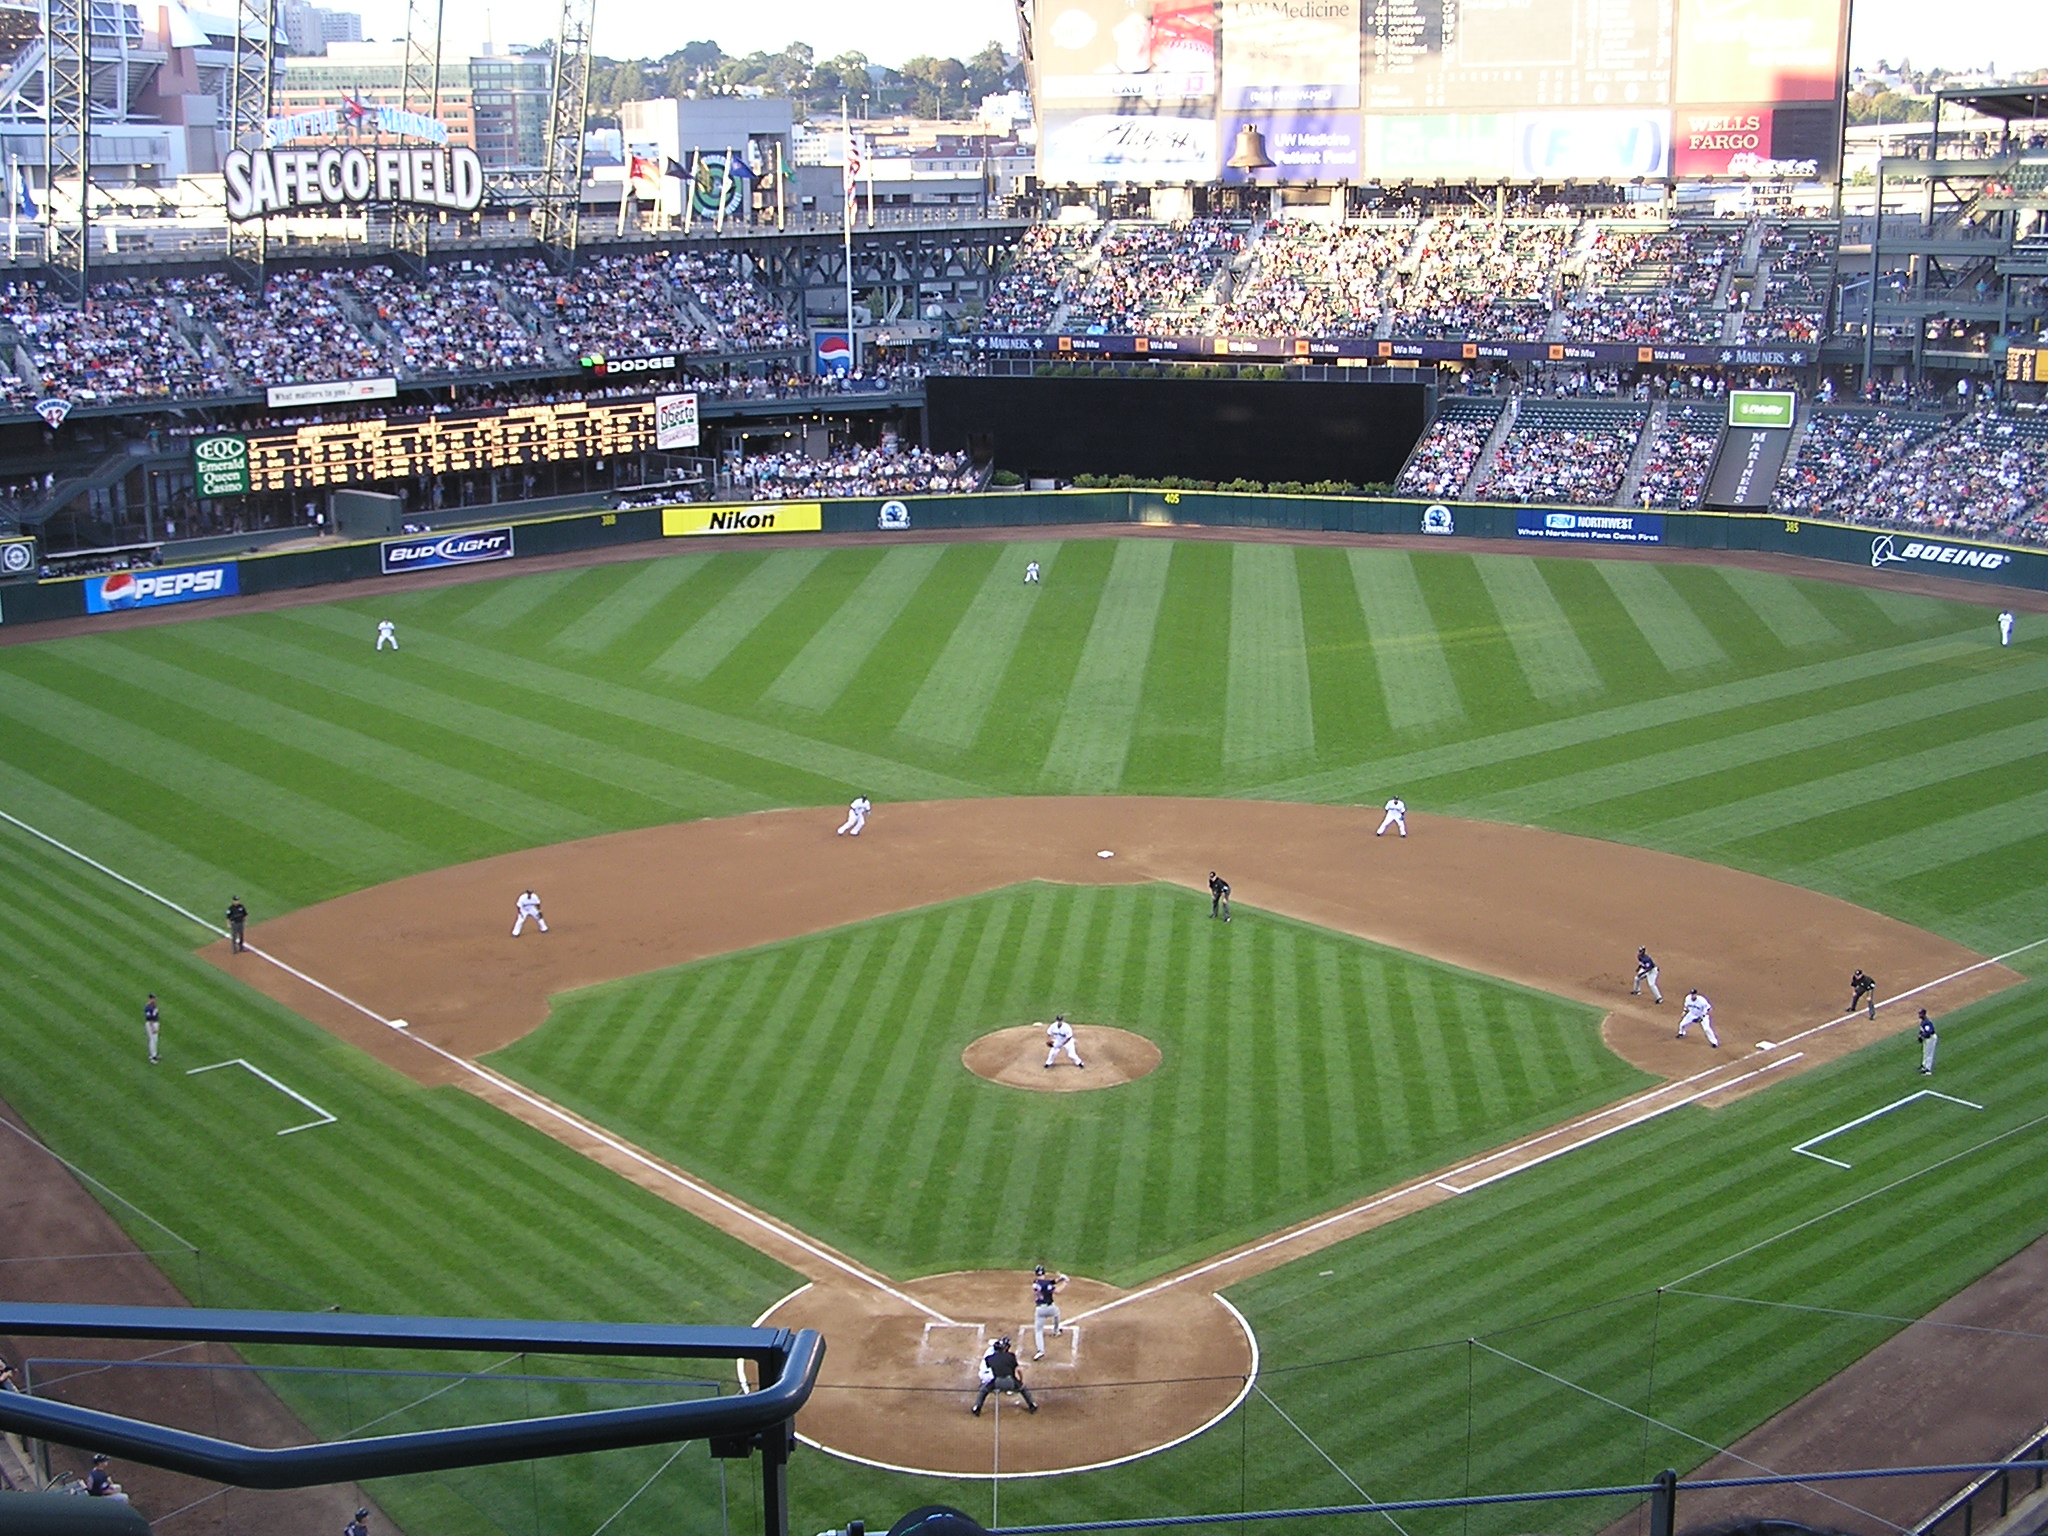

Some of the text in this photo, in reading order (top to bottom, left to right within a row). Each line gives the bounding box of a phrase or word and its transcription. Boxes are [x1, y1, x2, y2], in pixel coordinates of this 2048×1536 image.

[1272, 0, 1350, 18] Medicine
[265, 109, 339, 147] SEATTLE
[377, 106, 448, 145] MARINERS
[1687, 116, 1760, 132] WELLS
[1298, 133, 1350, 147] Medicine
[1689, 135, 1759, 150] FARGO
[225, 148, 483, 219] SAFECO FIELD
[607, 356, 675, 373] DODGE
[1736, 350, 1785, 364] MARINERS
[45, 409, 64, 424] 42
[661, 406, 694, 427] Oberto
[203, 440, 242, 459] EQC
[197, 458, 245, 473] Emerald
[1733, 432, 1767, 504] MARINERS
[203, 472, 241, 486] Queen
[203, 483, 243, 494] Casino
[1164, 493, 1180, 504] 405
[709, 512, 775, 530] Nikon
[1577, 516, 1634, 530] NORTHWEST
[1517, 528, 1659, 541] Where Northwest Fans Come First
[389, 536, 506, 562] BUD LIGHT
[1901, 542, 2004, 569] BOEING
[135, 569, 223, 599] PEPSI
